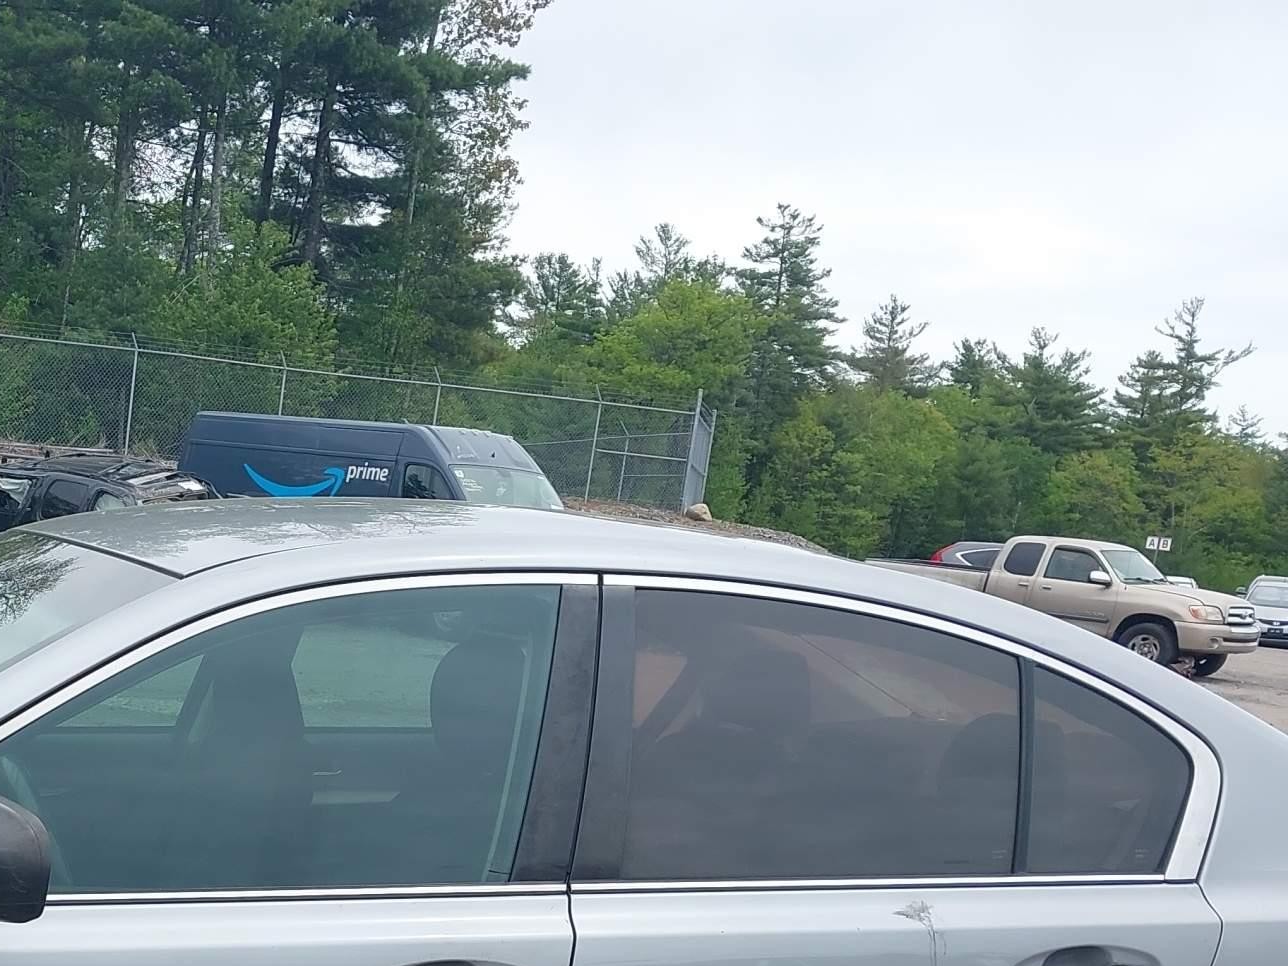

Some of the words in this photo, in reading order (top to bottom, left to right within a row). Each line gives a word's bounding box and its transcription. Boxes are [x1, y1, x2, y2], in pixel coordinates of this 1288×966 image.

[345, 461, 389, 483] prime
[1148, 538, 1156, 548] A
[1161, 539, 1169, 549] B
